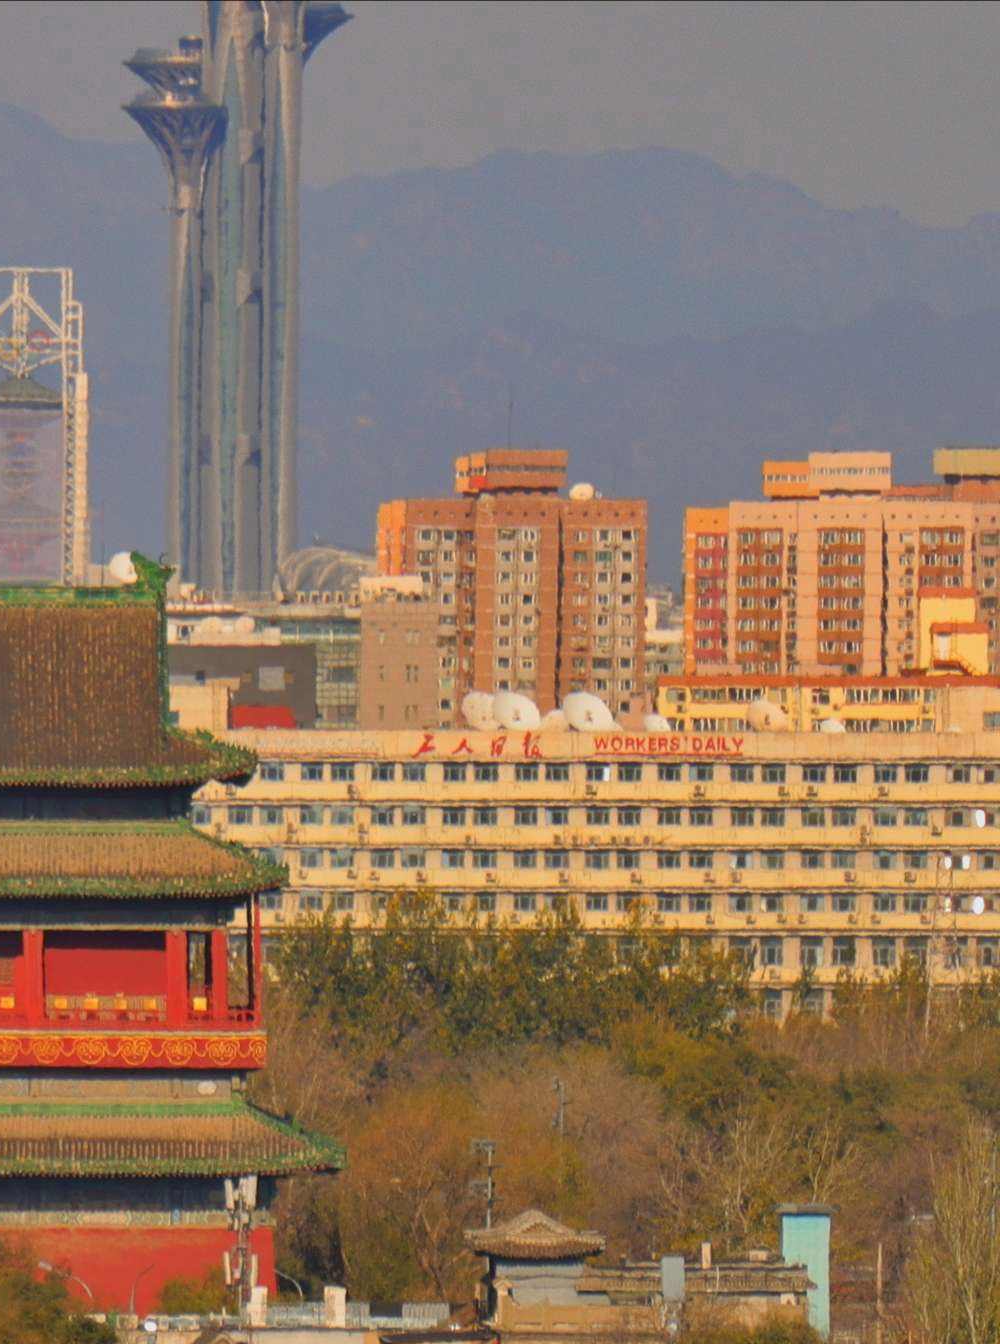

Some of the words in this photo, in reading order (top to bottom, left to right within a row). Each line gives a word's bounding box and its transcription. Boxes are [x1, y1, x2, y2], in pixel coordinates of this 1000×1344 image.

[411, 730, 544, 758] 工人日报
[692, 735, 744, 751] DAILY
